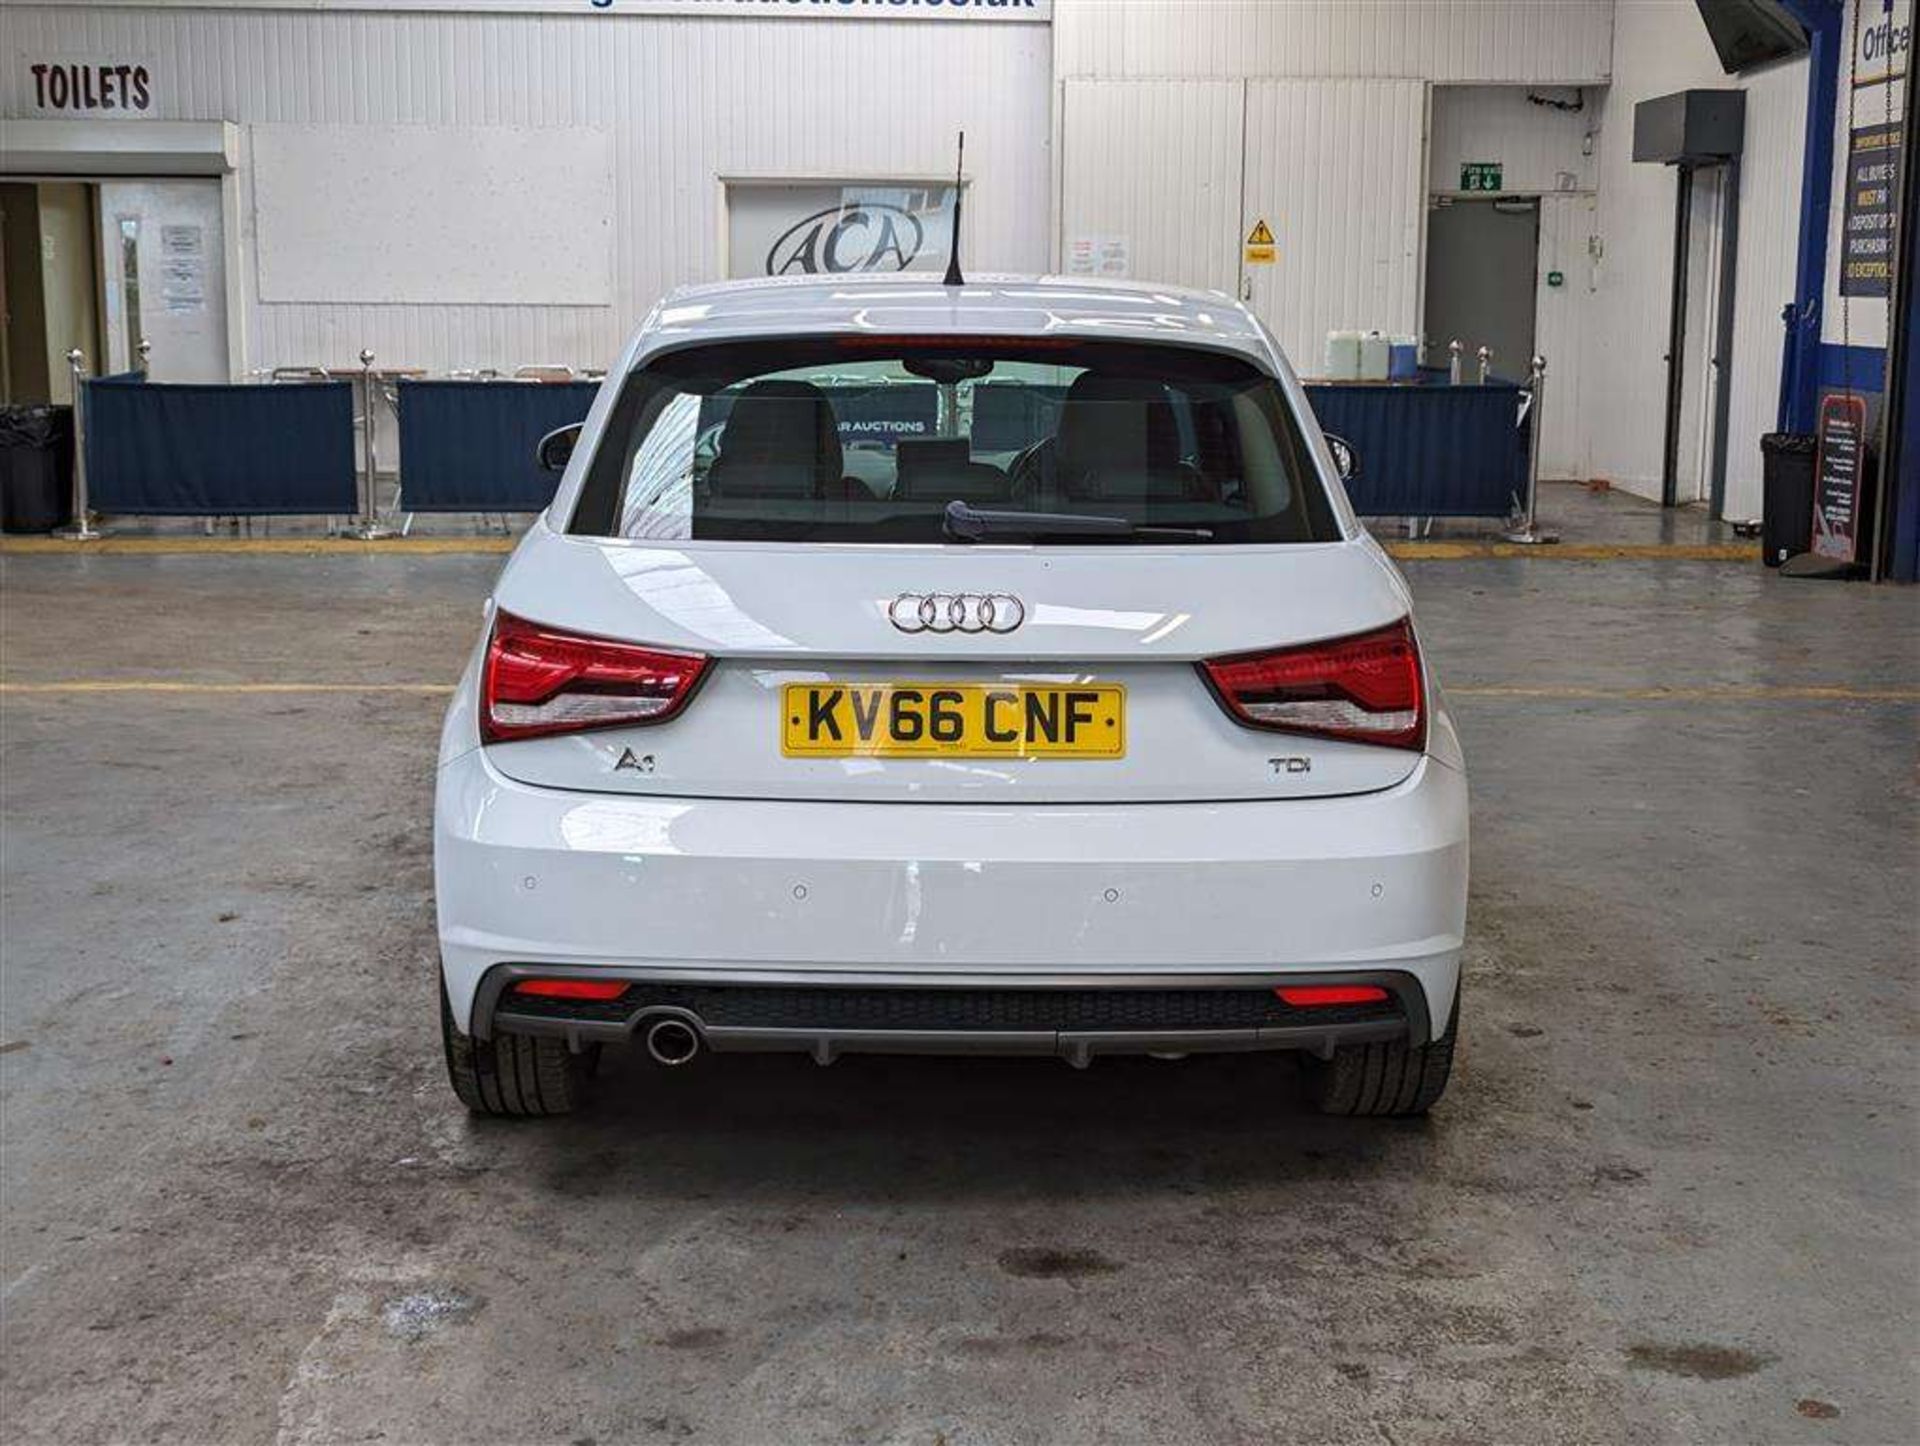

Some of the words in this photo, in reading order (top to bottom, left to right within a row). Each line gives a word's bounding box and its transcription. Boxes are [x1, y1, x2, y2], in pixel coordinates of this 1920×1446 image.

[1863, 25, 1911, 60] Offce
[31, 64, 150, 110] TOILETS
[779, 211, 905, 275] ACA
[852, 421, 925, 433] AUCTIONS
[808, 690, 964, 742] KV66
[984, 692, 1099, 743] CNF
